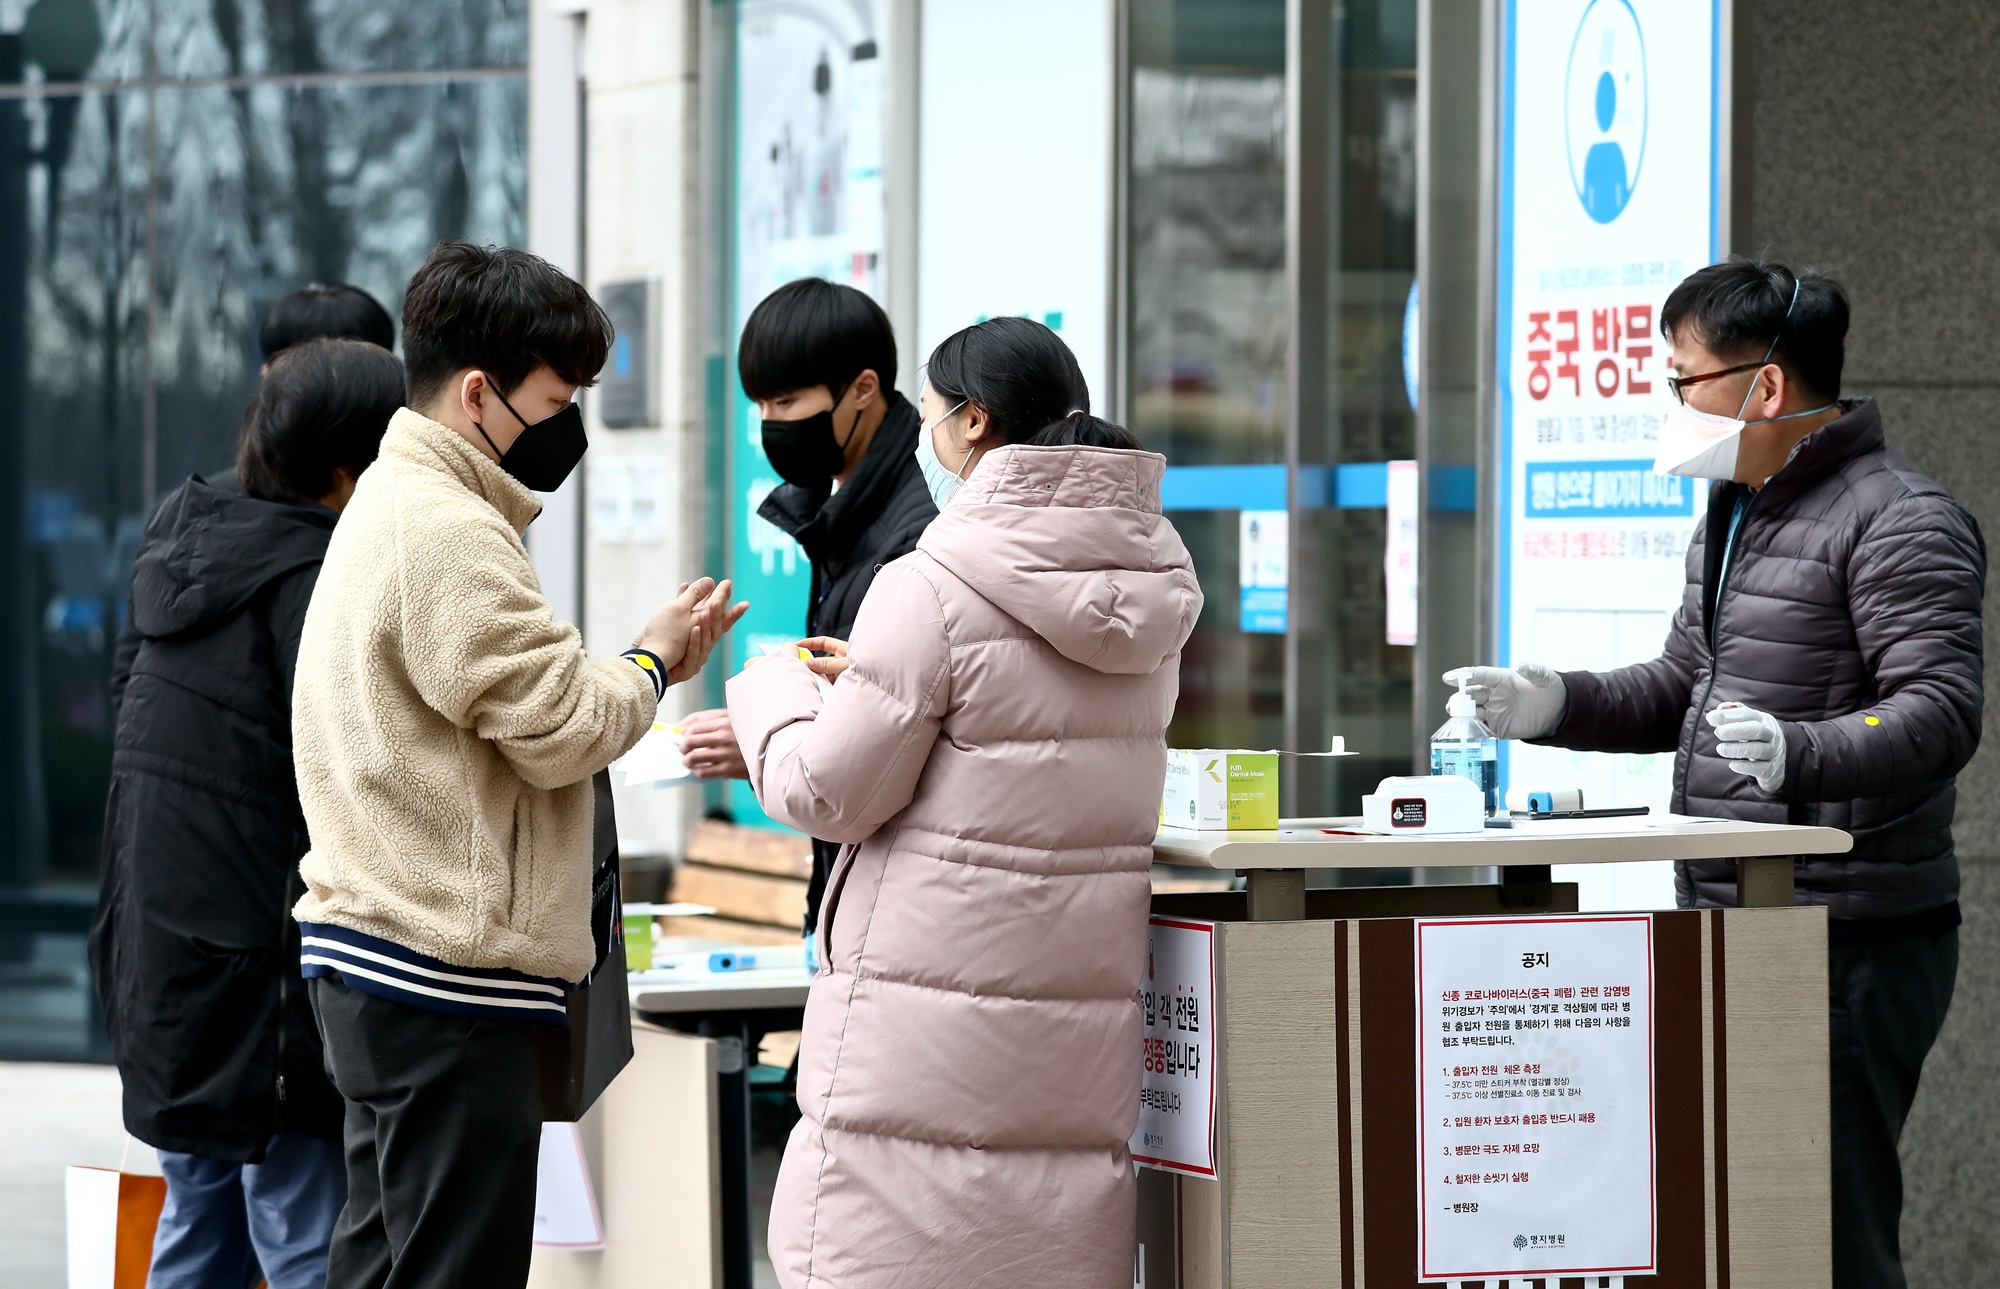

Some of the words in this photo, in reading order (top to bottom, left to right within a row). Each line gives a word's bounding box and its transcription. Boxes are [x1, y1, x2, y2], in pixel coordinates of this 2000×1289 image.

[1528, 310, 1580, 400] 중국
[1593, 305, 1652, 398] 방문
[1521, 951, 1549, 968] 공지
[1442, 991, 1460, 1002] 신종
[1464, 988, 1549, 1000] 코로나바이러스(중국
[1554, 987, 1576, 999] 폐렴)
[1580, 987, 1599, 998] 관련
[1603, 986, 1630, 997] 감염병
[1160, 994, 1171, 1029] 객
[1176, 996, 1199, 1032] 전원
[1442, 1005, 1484, 1016] 위기경보가
[1563, 1003, 1597, 1013] 격상됨에
[1601, 1002, 1618, 1012] 따라
[1622, 1001, 1630, 1012] 병
[1442, 1021, 1451, 1032] 원
[1455, 1021, 1481, 1031] 출입자
[1485, 1020, 1510, 1031] 전원을
[1514, 1019, 1549, 1030] 통제하기
[1554, 1018, 1571, 1028] 위해
[1575, 1017, 1601, 1028] 다음의
[1605, 1016, 1631, 1027] 사항을
[1442, 1036, 1459, 1047] 협조
[1462, 1035, 1515, 1046] 부탁드립니다.
[1442, 1067, 1450, 1077] 1.
[1453, 1066, 1478, 1077] 출입자
[1481, 1065, 1498, 1076] 전원
[1504, 1064, 1521, 1075] 체온
[1523, 1064, 1541, 1075] 측정
[1474, 1080, 1488, 1088] 미만
[1490, 1079, 1511, 1088] 스티커
[1513, 1078, 1527, 1087] 부착
[1553, 1077, 1570, 1086] 정상)
[1474, 1091, 1488, 1099] 이상
[1490, 1090, 1524, 1099] 선별진료소
[1526, 1089, 1540, 1098] 이동
[1542, 1088, 1556, 1097] 진료
[1558, 1088, 1565, 1097] 및
[1567, 1088, 1581, 1096] 검사
[1141, 1087, 1181, 1115] 부탁드립니다
[1443, 1118, 1451, 1127] 2.
[1454, 1116, 1472, 1127] 입원
[1474, 1116, 1491, 1127] 환자
[1494, 1115, 1519, 1126] 보호자
[1522, 1114, 1548, 1125] 출입증
[1550, 1113, 1576, 1124] 반드시
[1578, 1113, 1596, 1123] 패용
[1443, 1147, 1452, 1156] 3.
[1455, 1145, 1480, 1156] 병문안
[1483, 1144, 1500, 1155] 극도
[1503, 1144, 1520, 1154] 자제
[1523, 1143, 1540, 1154] 요망
[1443, 1176, 1452, 1185] 4.
[1455, 1174, 1480, 1185] 철저한
[1483, 1173, 1509, 1183] 손씻기
[1512, 1172, 1529, 1183] 실행
[1453, 1202, 1479, 1214] 병원장
[1530, 1234, 1565, 1245] 명지병원
